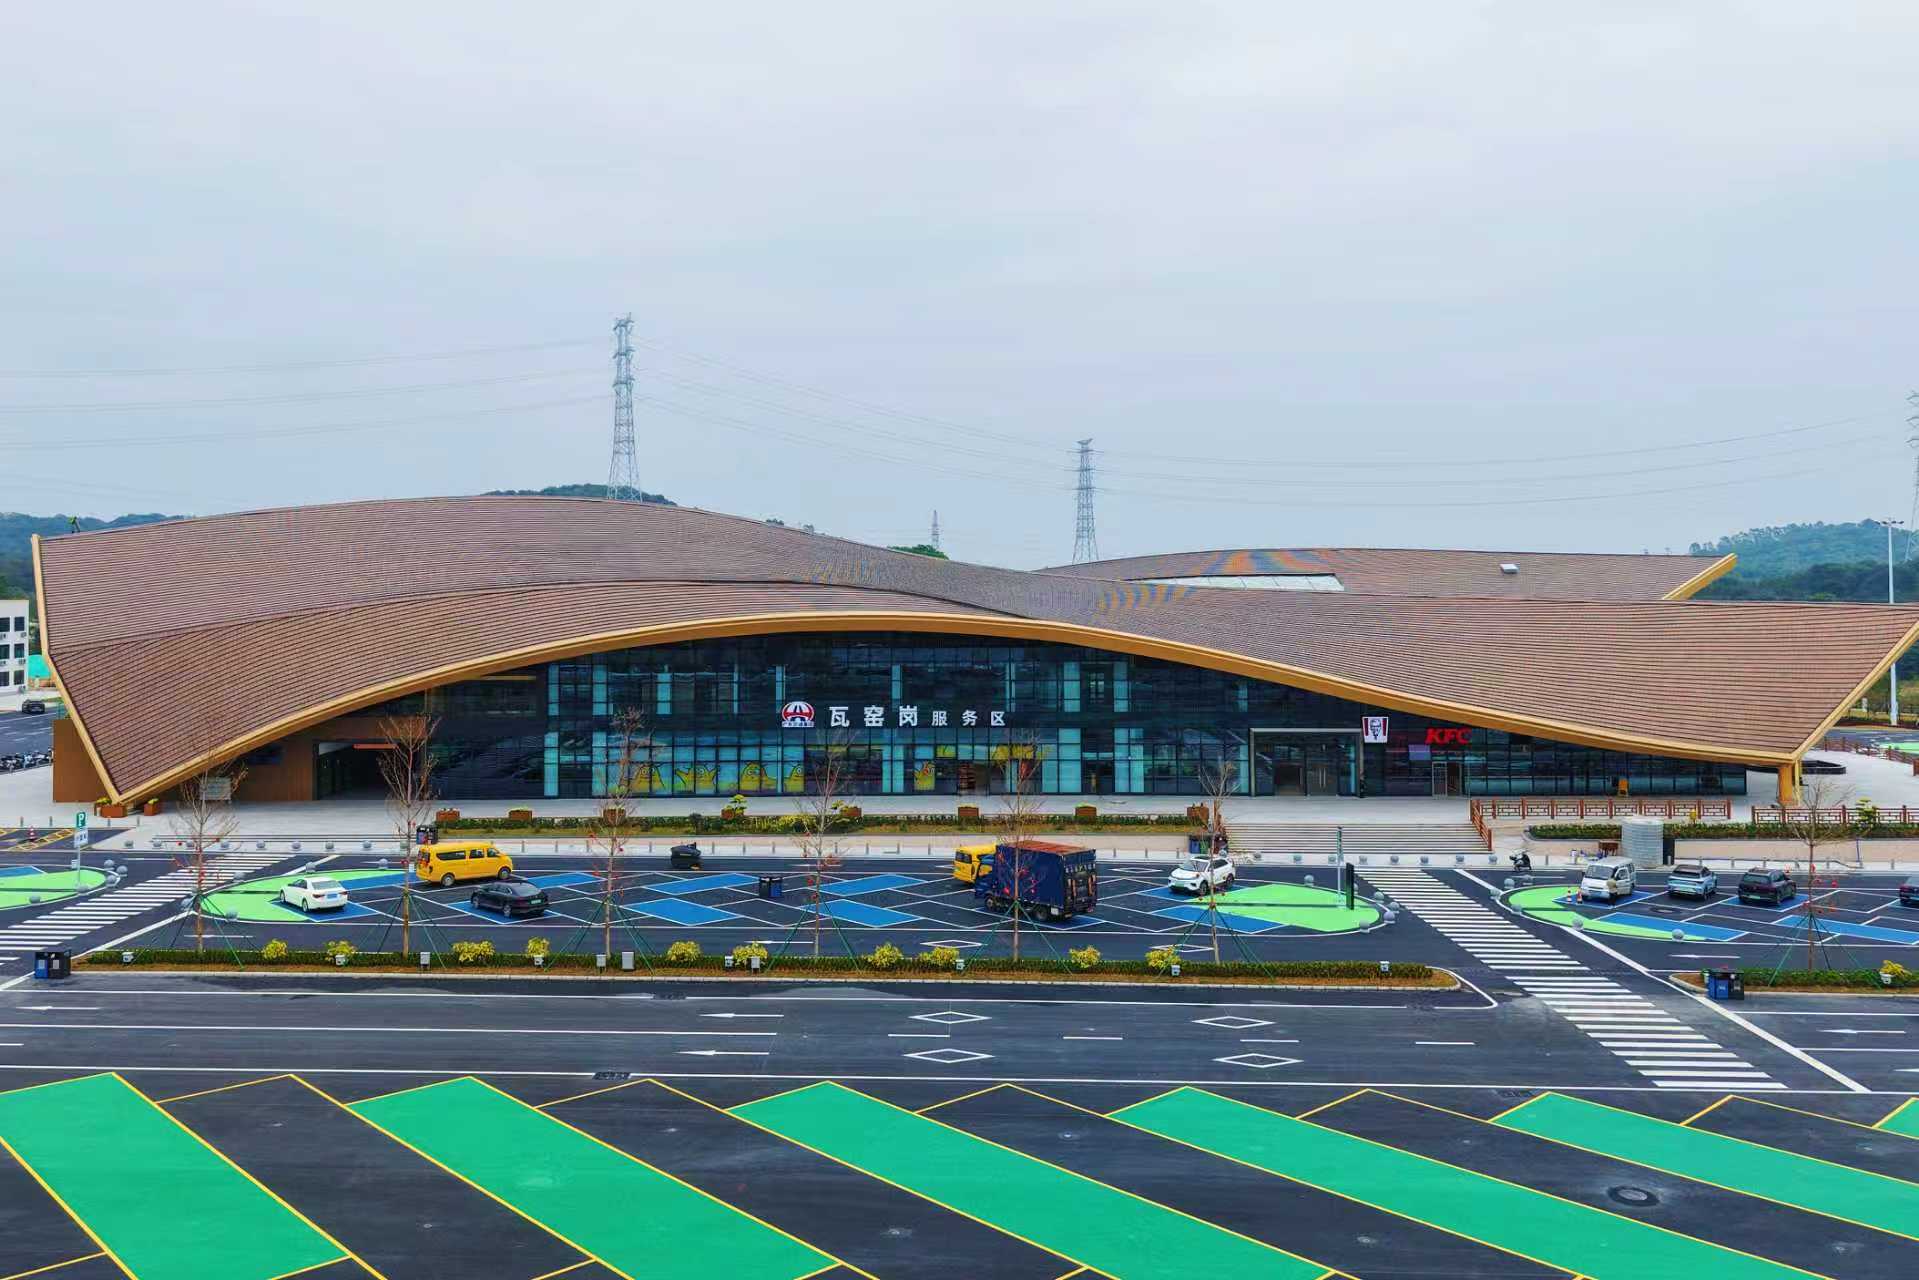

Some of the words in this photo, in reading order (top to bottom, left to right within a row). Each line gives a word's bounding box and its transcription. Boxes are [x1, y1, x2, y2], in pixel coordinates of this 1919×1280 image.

[829, 705, 1006, 728] 瓦窑岗服务区
[1425, 728, 1472, 745] KFC
